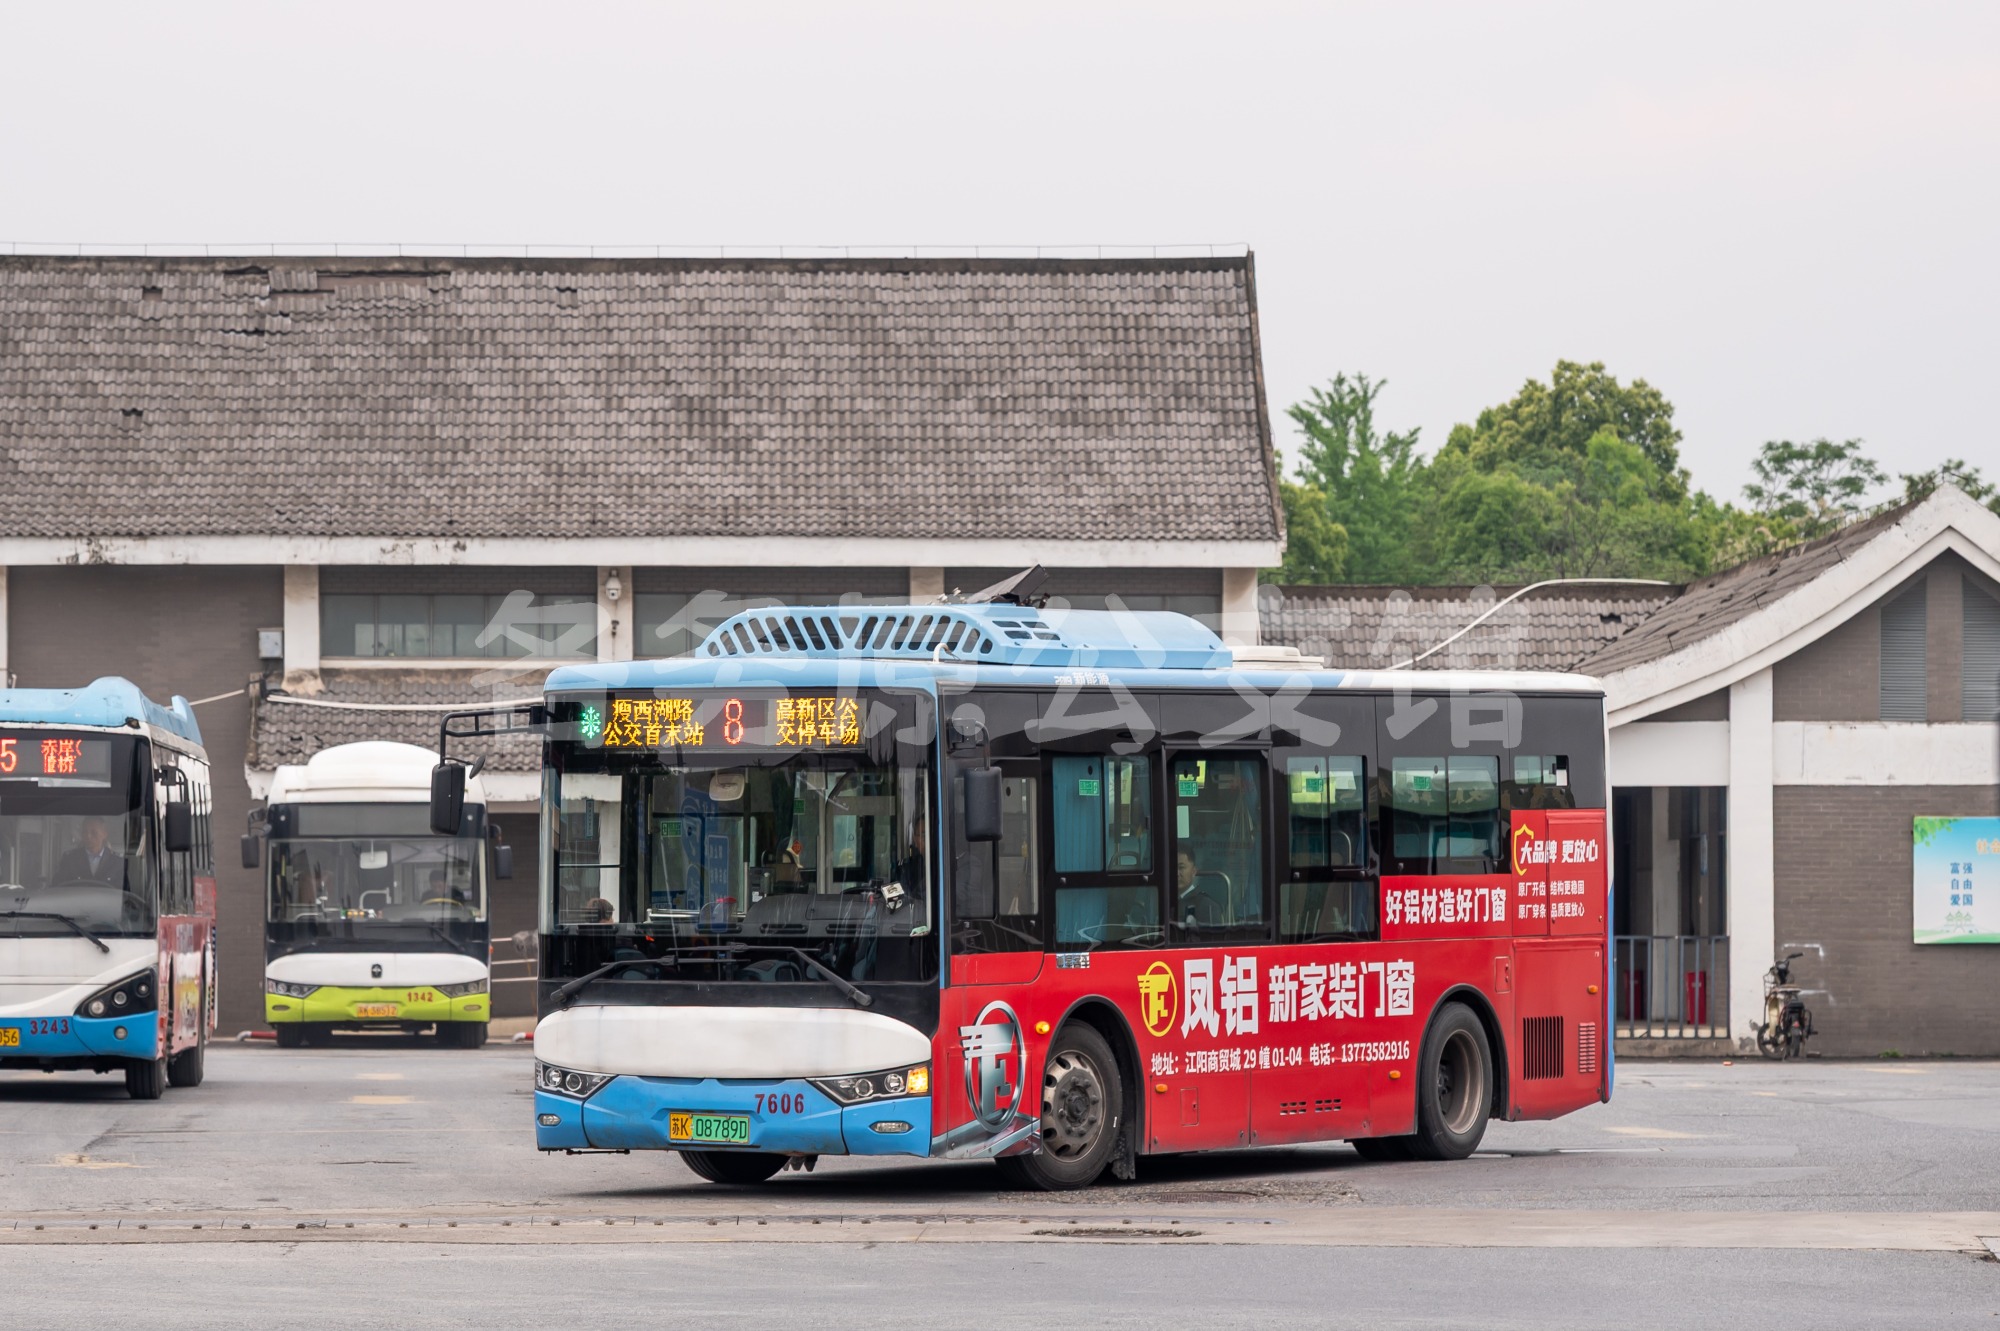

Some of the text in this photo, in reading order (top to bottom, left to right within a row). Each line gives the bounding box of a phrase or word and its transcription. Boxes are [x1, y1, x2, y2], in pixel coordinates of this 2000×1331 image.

[612, 699, 694, 722] 瘦西湖路
[776, 698, 858, 721] 高新区公
[724, 699, 744, 744] 8
[603, 722, 704, 746] 公交首末站
[775, 722, 859, 745] 交停车场
[1520, 839, 1599, 864] 大品牌 更放心
[1950, 862, 1973, 874] 富强
[1550, 880, 1585, 896] 结构更稳固
[1951, 878, 1972, 890] 自由
[1386, 887, 1507, 925] 好铝材造好门窗
[1550, 902, 1585, 918] 品质更放心
[1950, 894, 1973, 906] 爱国
[1181, 954, 1415, 1039] 凤铝 新家装门窗
[30, 1020, 70, 1035] 3243
[754, 1093, 805, 1114] 7606
